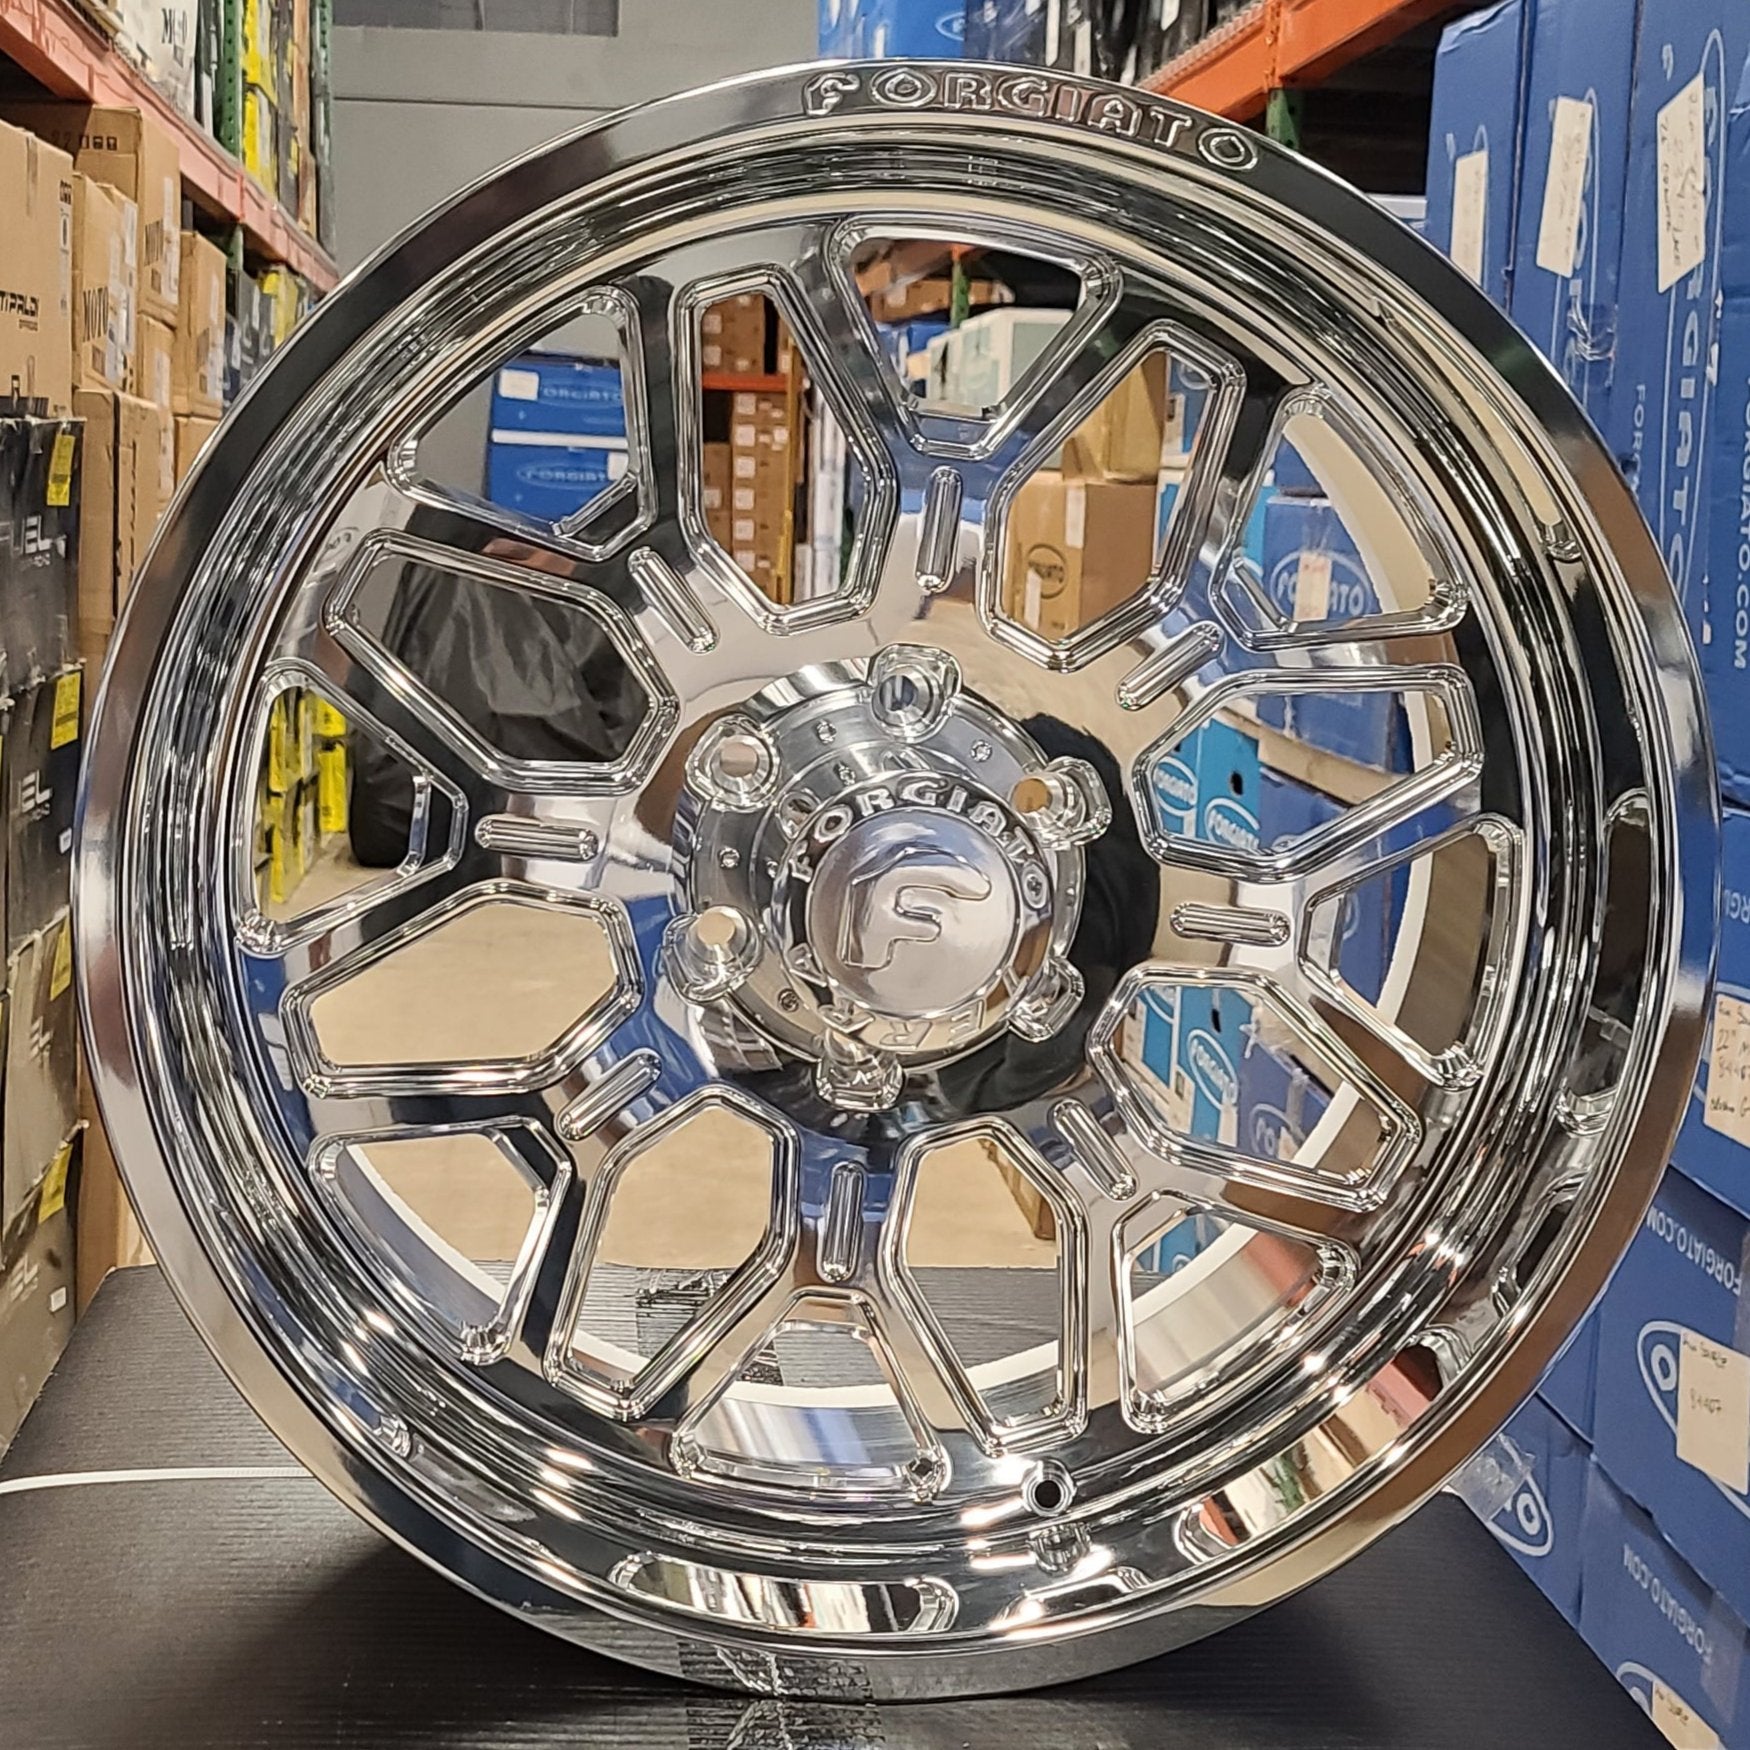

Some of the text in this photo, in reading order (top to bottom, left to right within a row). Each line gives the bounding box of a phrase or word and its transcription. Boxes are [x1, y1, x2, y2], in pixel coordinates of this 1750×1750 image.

[804, 70, 1260, 172] FORGIATO
[82, 286, 109, 342] MOTO
[790, 772, 1050, 909] FORGIATO
[1646, 1205, 1742, 1297] FORGIATO.COM
[1623, 1543, 1713, 1665] FORGIATO.COM
